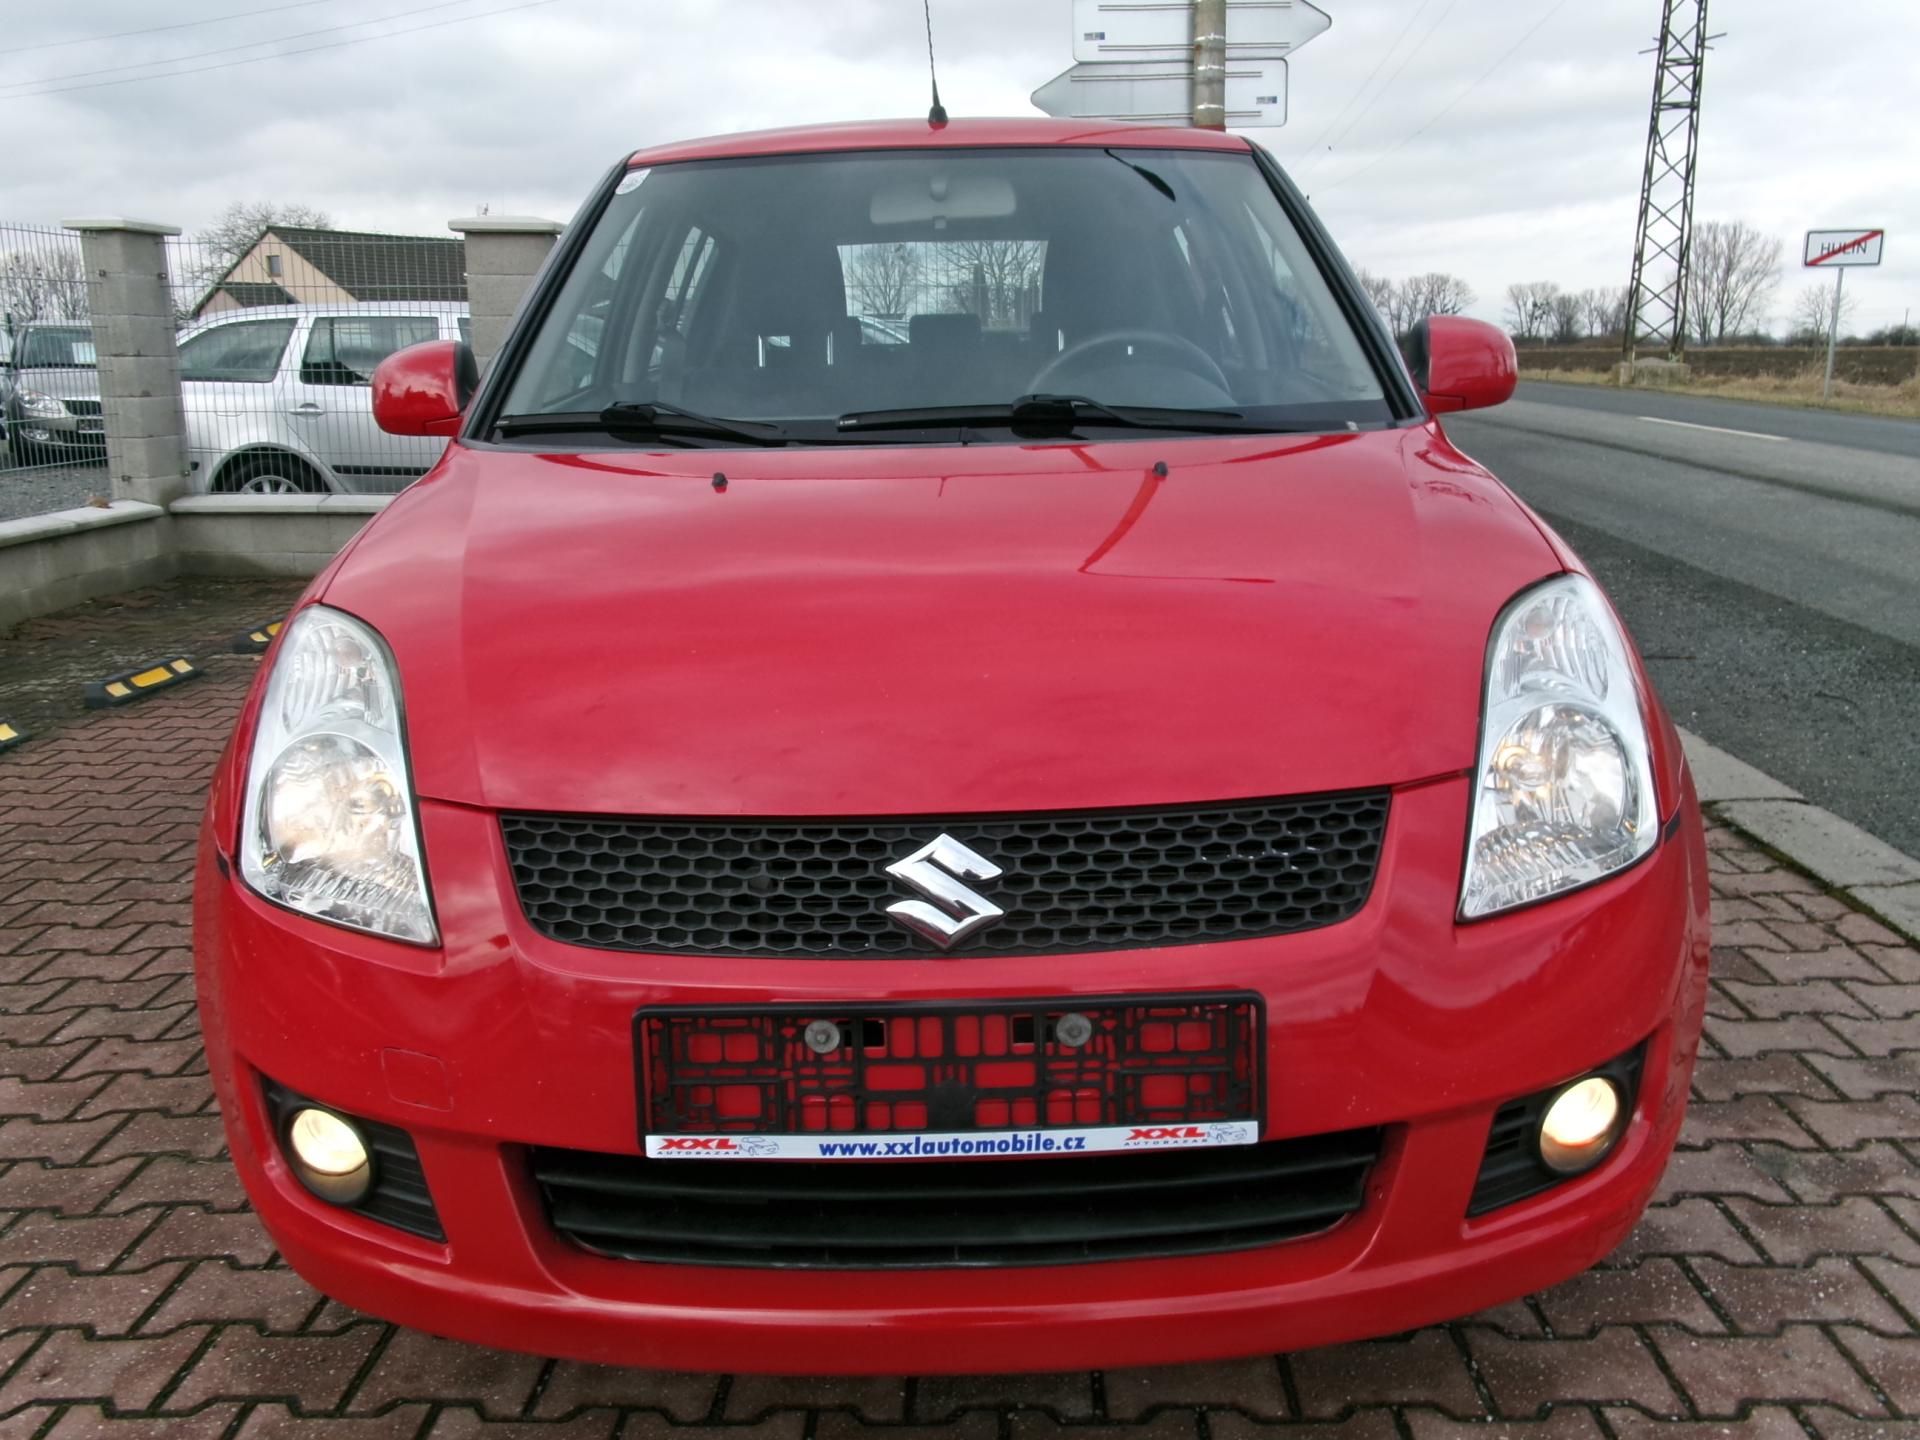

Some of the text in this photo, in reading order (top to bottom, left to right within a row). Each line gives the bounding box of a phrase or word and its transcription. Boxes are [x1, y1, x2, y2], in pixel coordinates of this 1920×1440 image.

[1126, 1126, 1206, 1140] XXL
[658, 1137, 738, 1150] XXL
[819, 1133, 1086, 1156] www.xxlautomobile.cz
